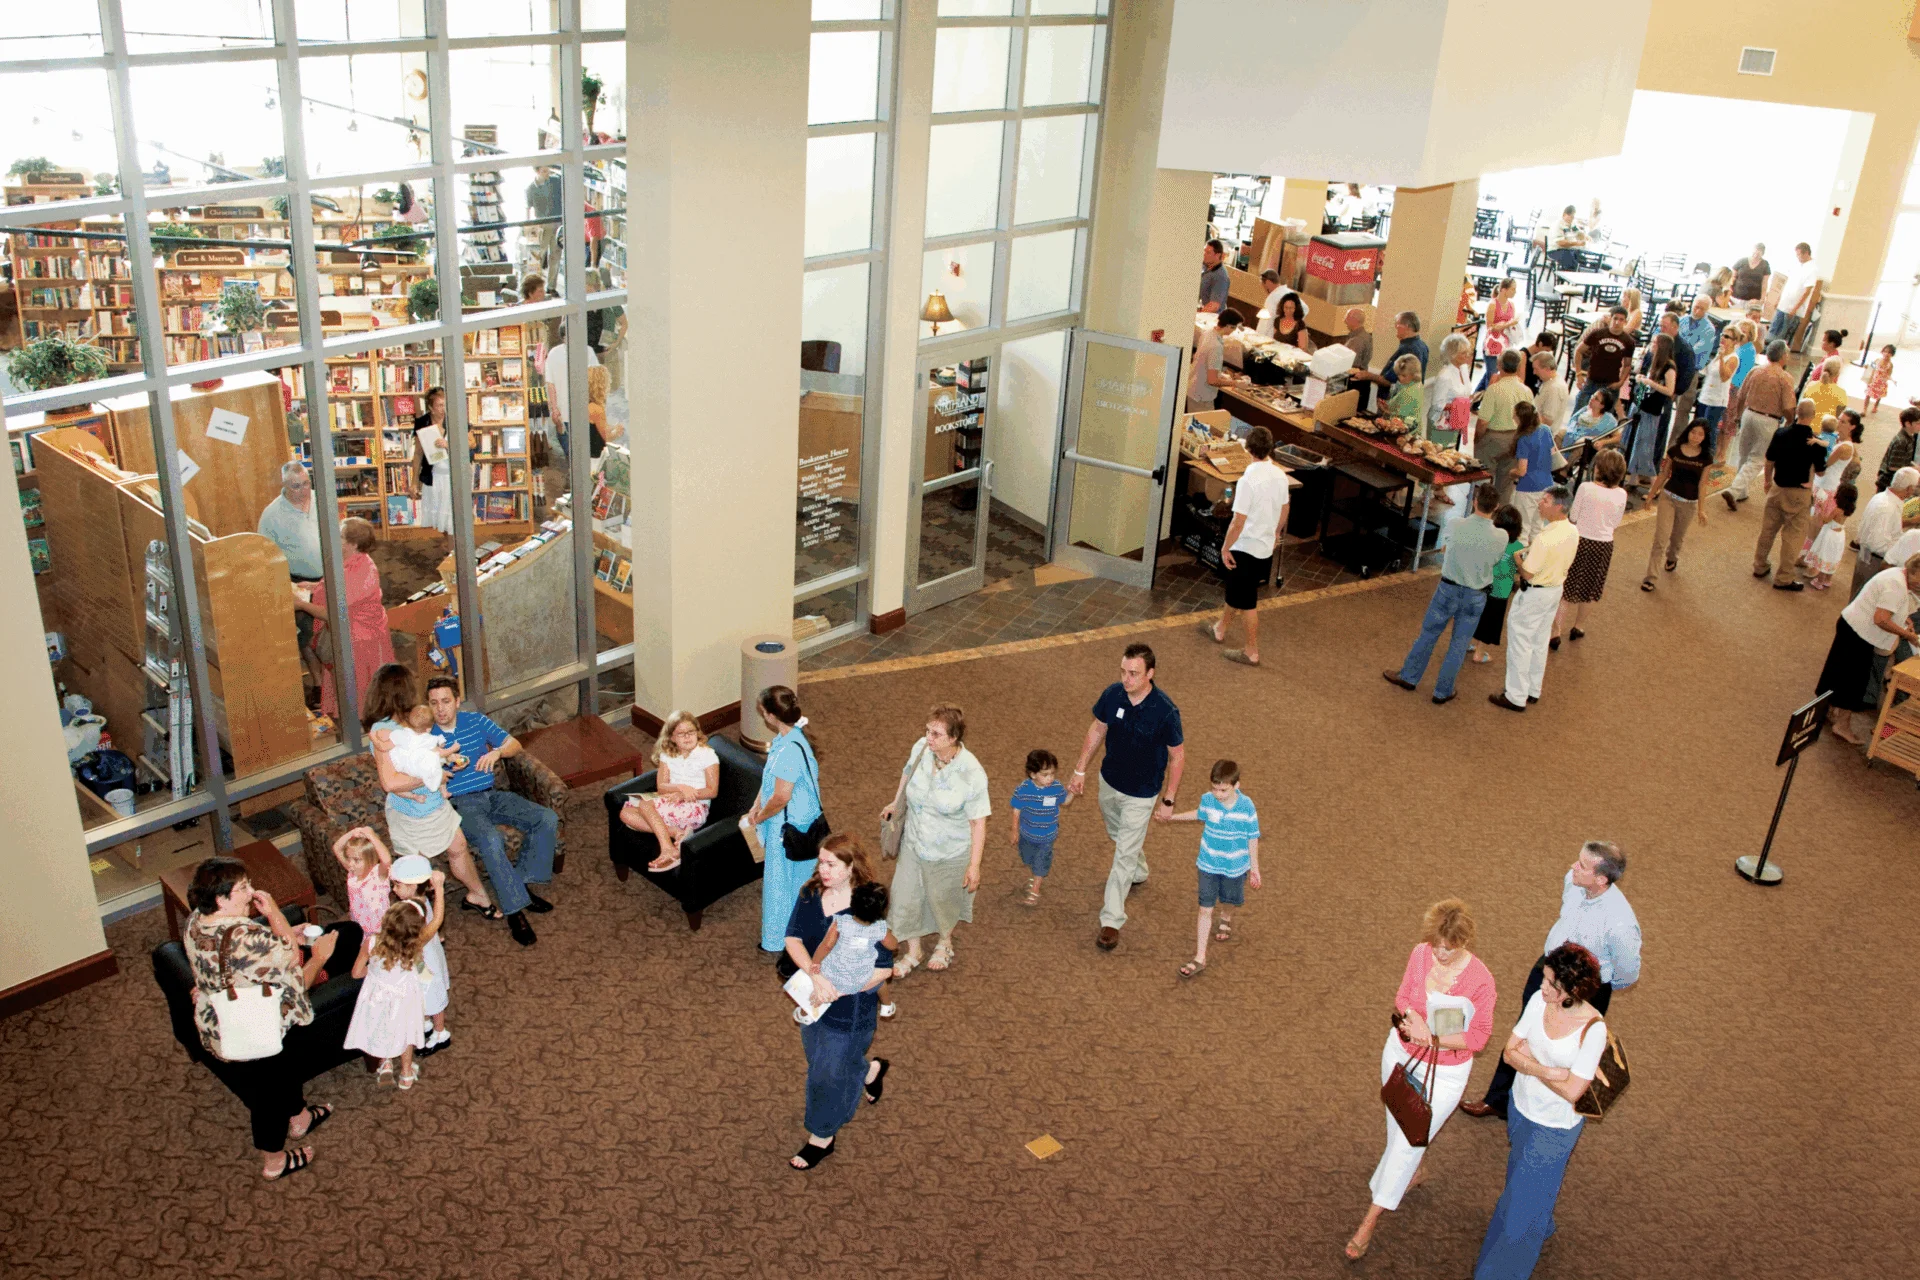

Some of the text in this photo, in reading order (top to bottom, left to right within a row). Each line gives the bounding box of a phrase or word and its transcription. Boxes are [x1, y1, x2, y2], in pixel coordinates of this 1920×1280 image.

[208, 254, 238, 263] Marriage
[934, 416, 978, 434] BOOKSTORE
[799, 448, 849, 466] Bookstore Hours
